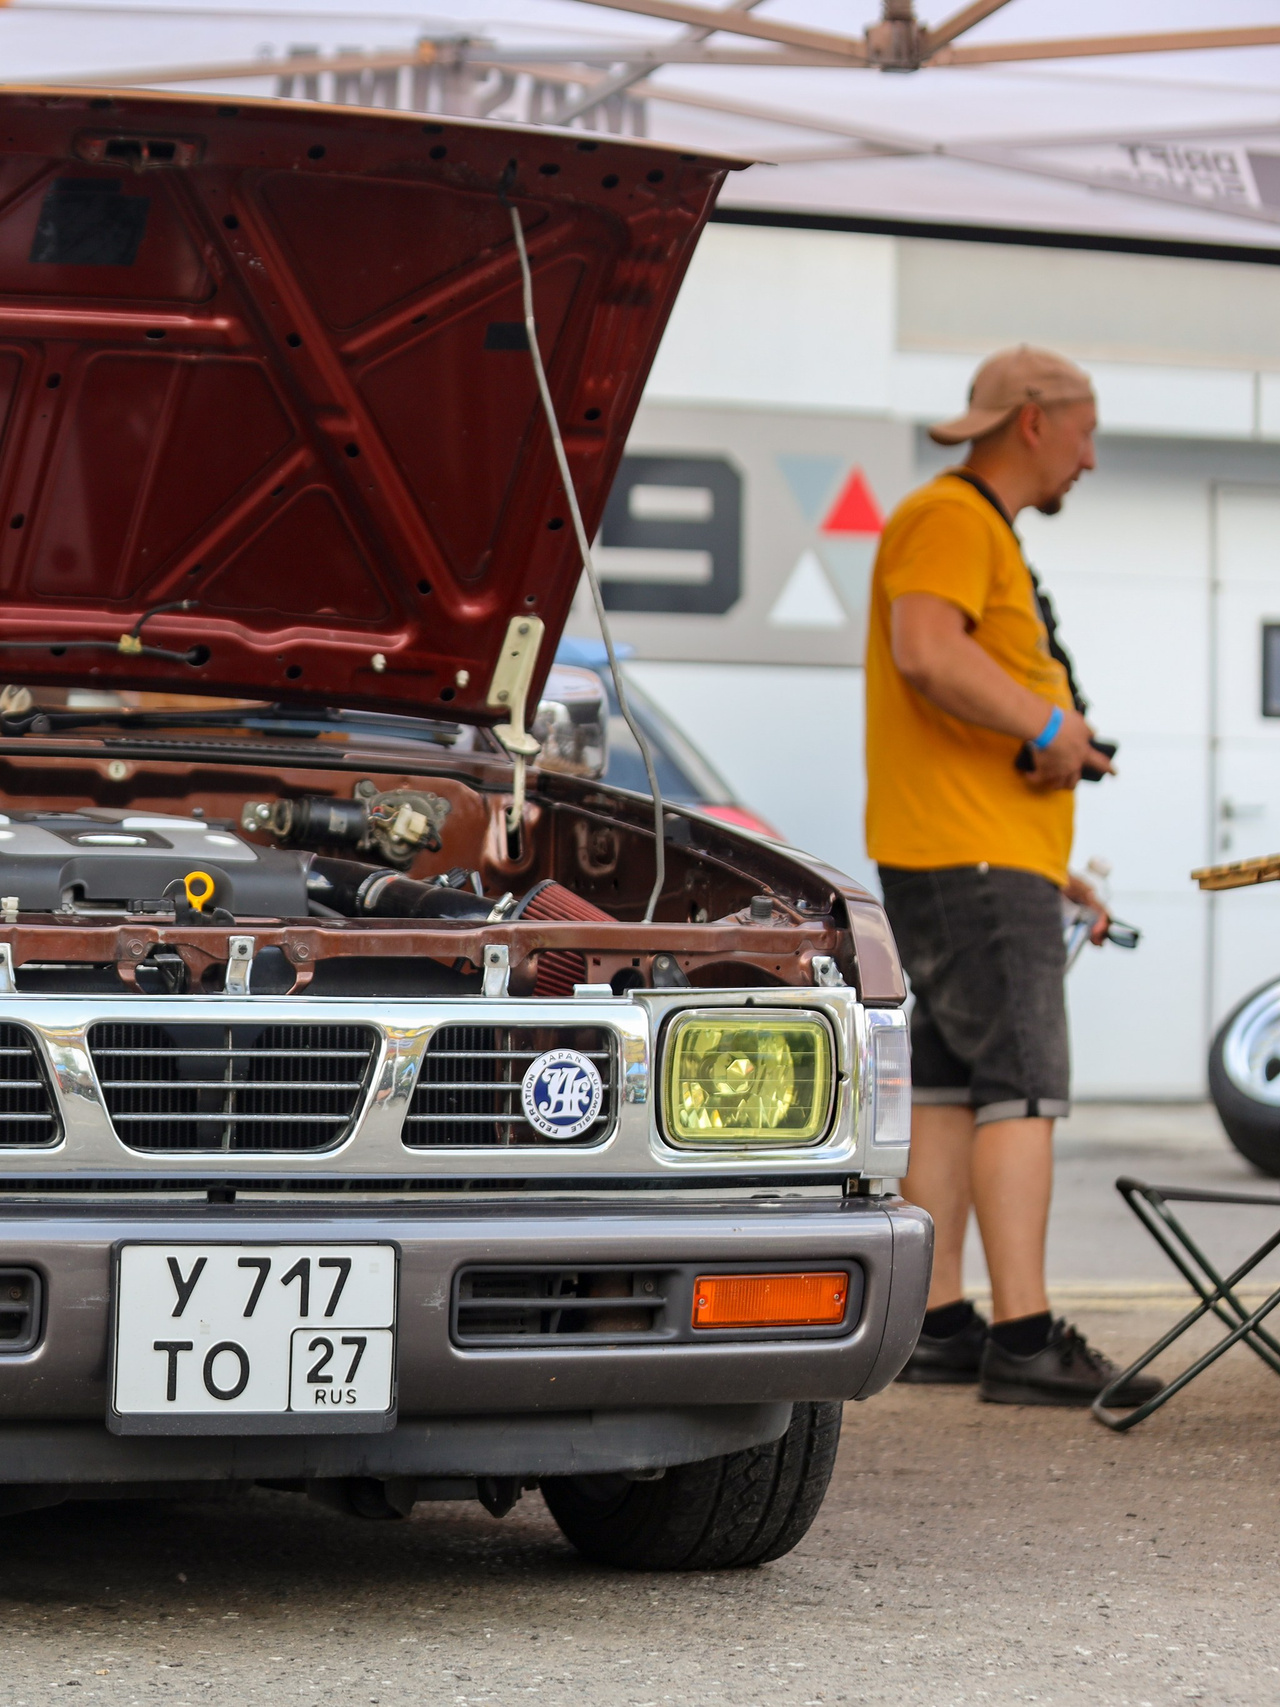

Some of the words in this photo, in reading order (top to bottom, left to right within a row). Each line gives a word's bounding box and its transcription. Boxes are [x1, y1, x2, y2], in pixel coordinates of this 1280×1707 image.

[541, 1052, 582, 1066] JAPAN
[524, 1074, 559, 1134] FEDERATION
[570, 1071, 600, 1133] AUTOMOBILE
[237, 1256, 352, 1318] 717
[306, 1336, 368, 1384] 27
[315, 1388, 357, 1405] RUS
